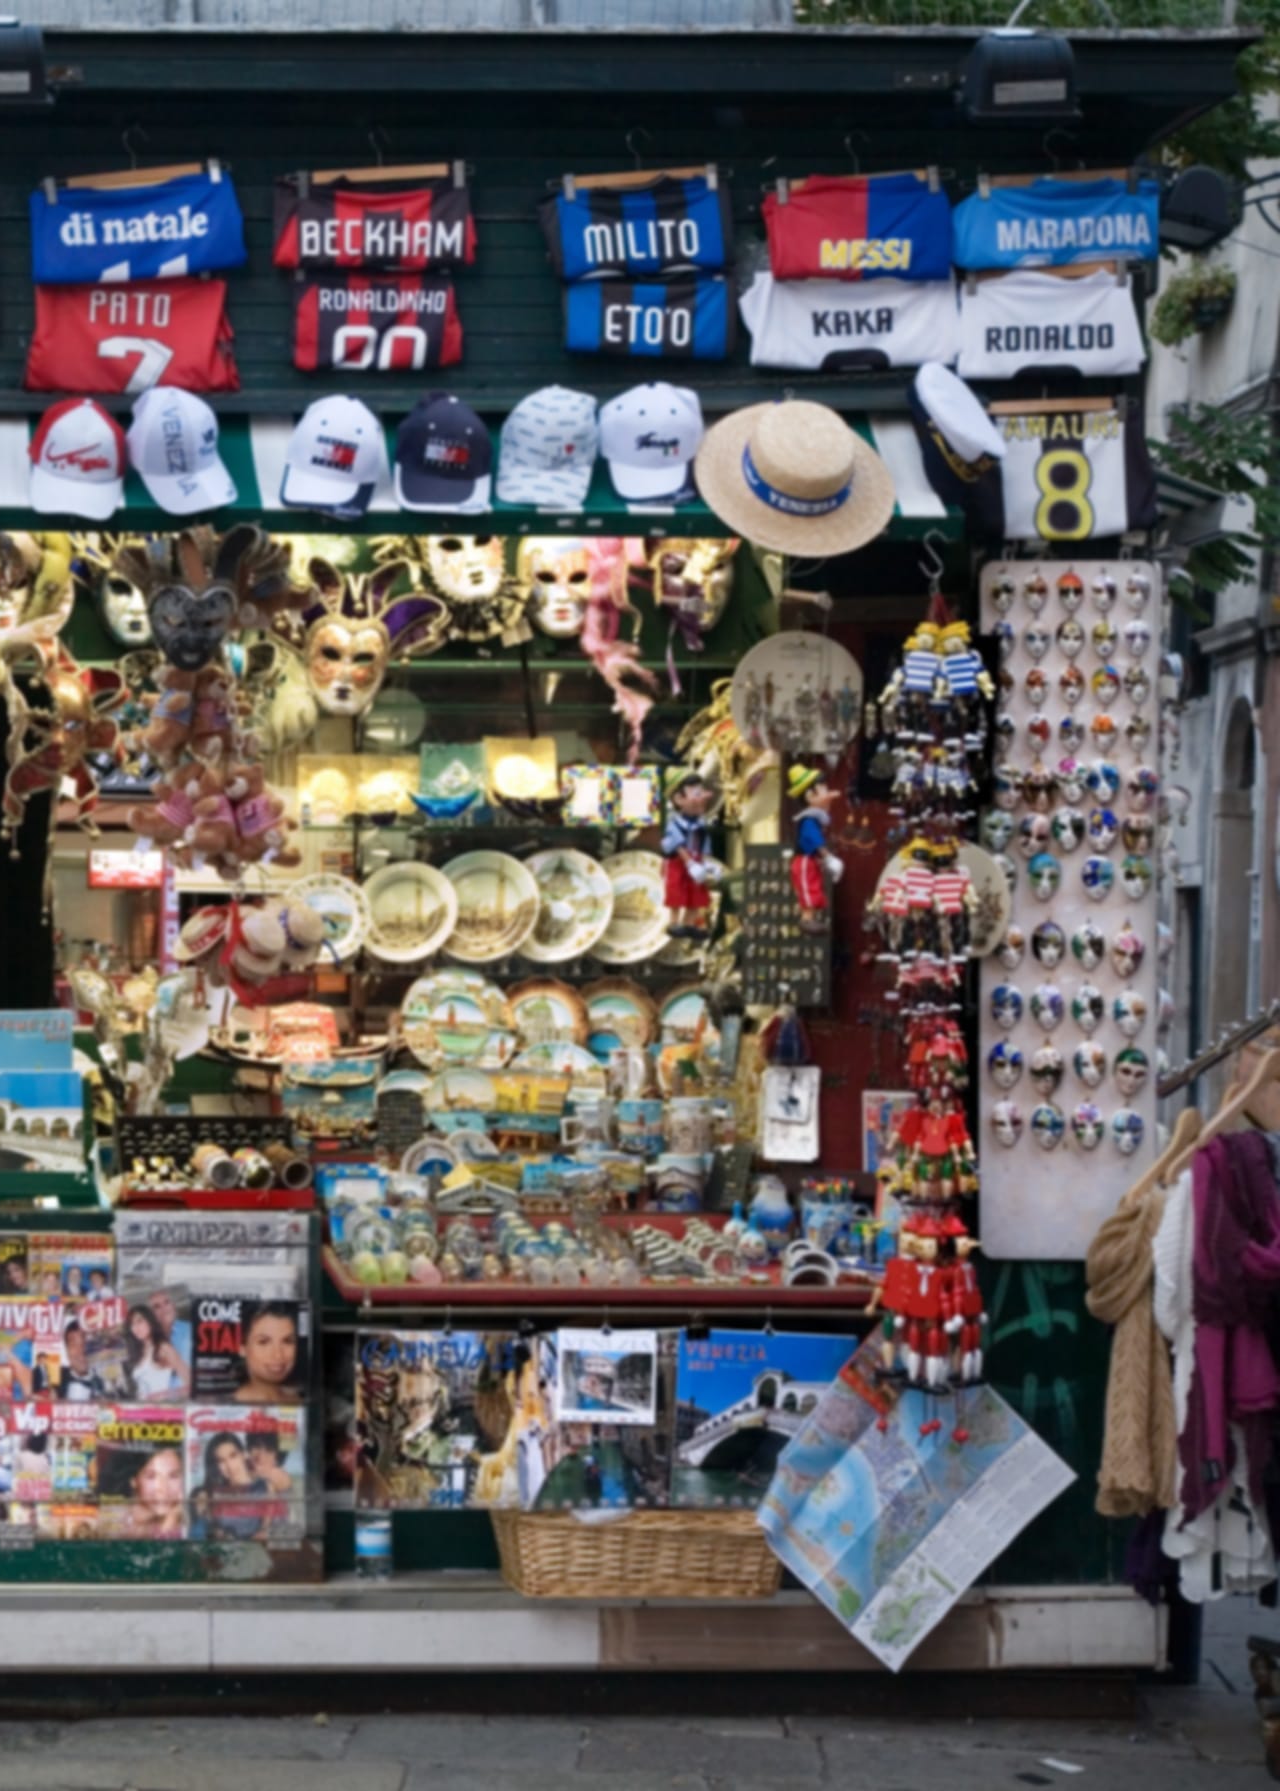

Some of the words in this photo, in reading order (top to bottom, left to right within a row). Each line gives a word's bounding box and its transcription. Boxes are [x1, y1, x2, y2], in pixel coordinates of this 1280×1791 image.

[60, 210, 96, 247] di
[104, 205, 209, 243] natale
[300, 220, 463, 257] BECKHAM
[583, 219, 699, 263] MILITO
[996, 214, 1151, 252] MARADONA
[820, 238, 912, 269] MESSI
[89, 291, 171, 327] PATO
[319, 287, 446, 314] RONALDINHO
[985, 323, 1114, 352] RONALDO
[1035, 448, 1095, 540] 8
[198, 1301, 241, 1322] COME
[198, 1322, 241, 1352] STAI
[686, 1342, 766, 1362] VENEZIA
